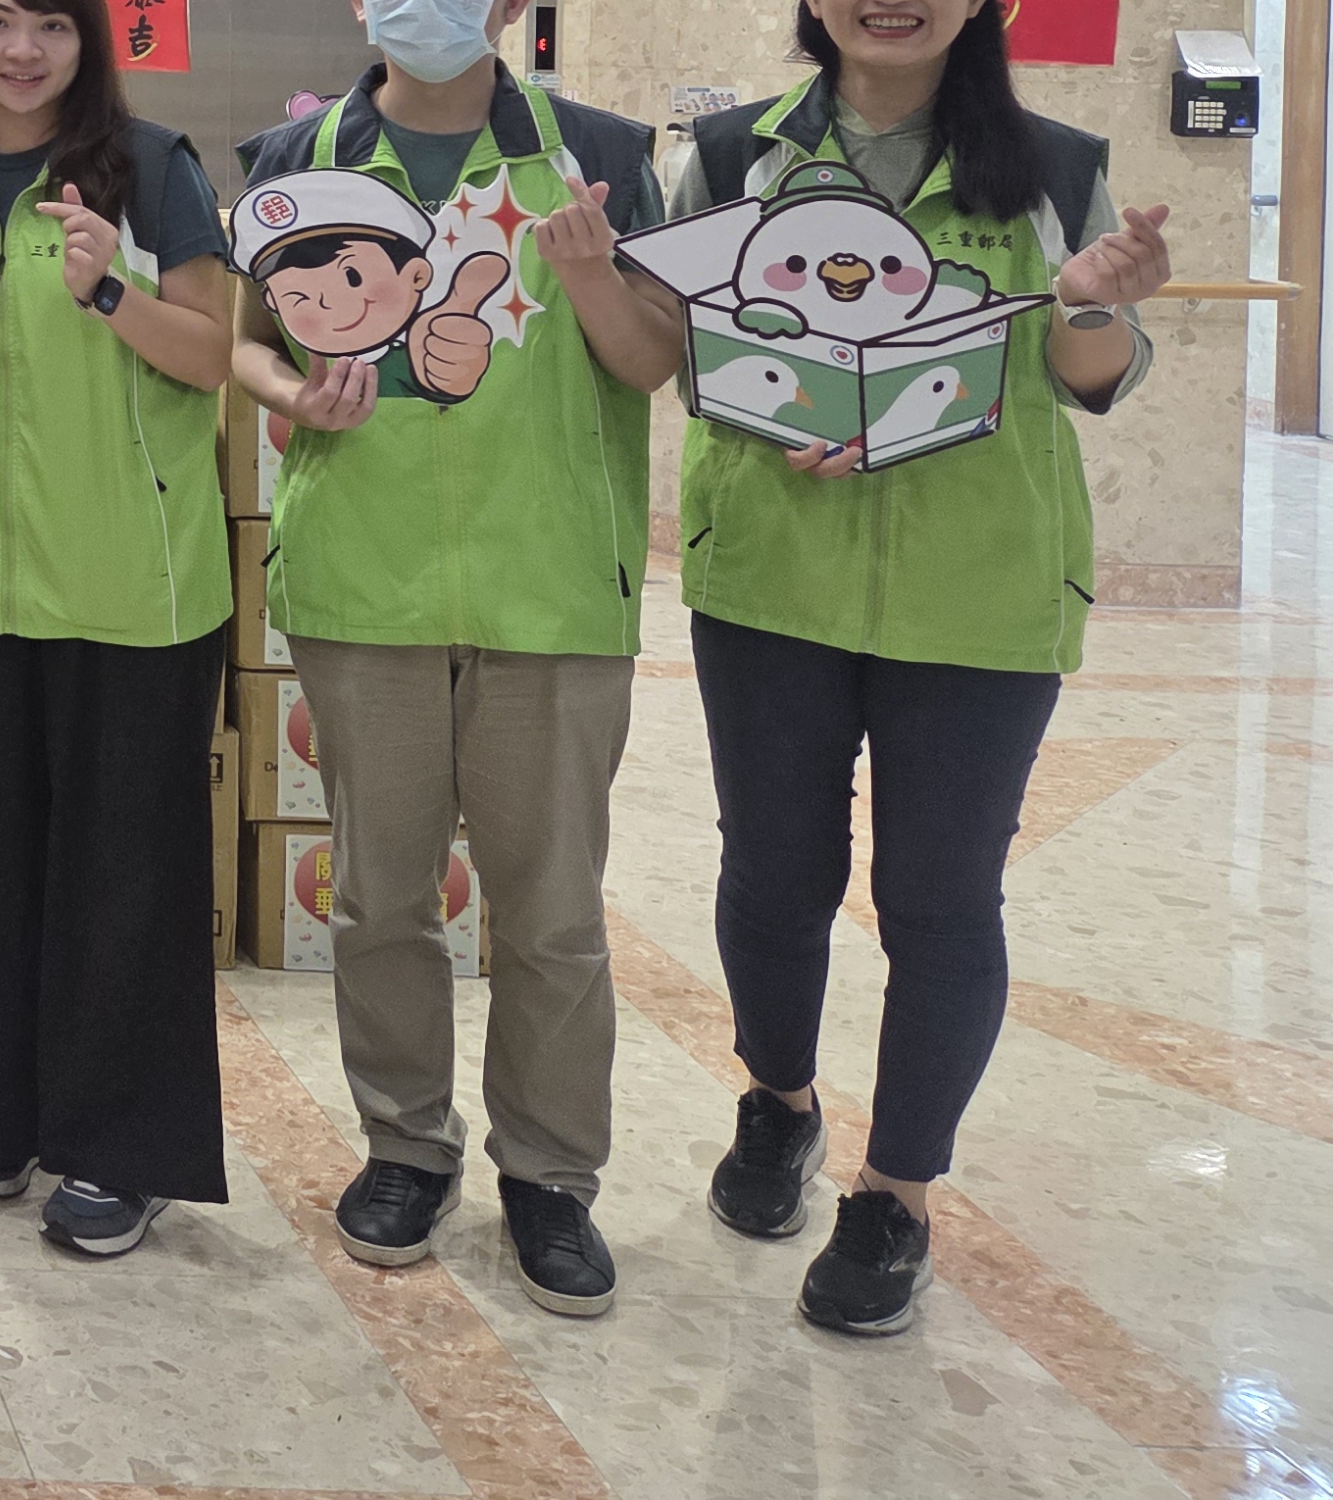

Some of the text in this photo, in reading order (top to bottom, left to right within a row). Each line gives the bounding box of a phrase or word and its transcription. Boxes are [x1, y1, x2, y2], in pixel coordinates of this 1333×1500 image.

[937, 231, 1013, 251] 三重郵局
[31, 243, 60, 258] 三重
